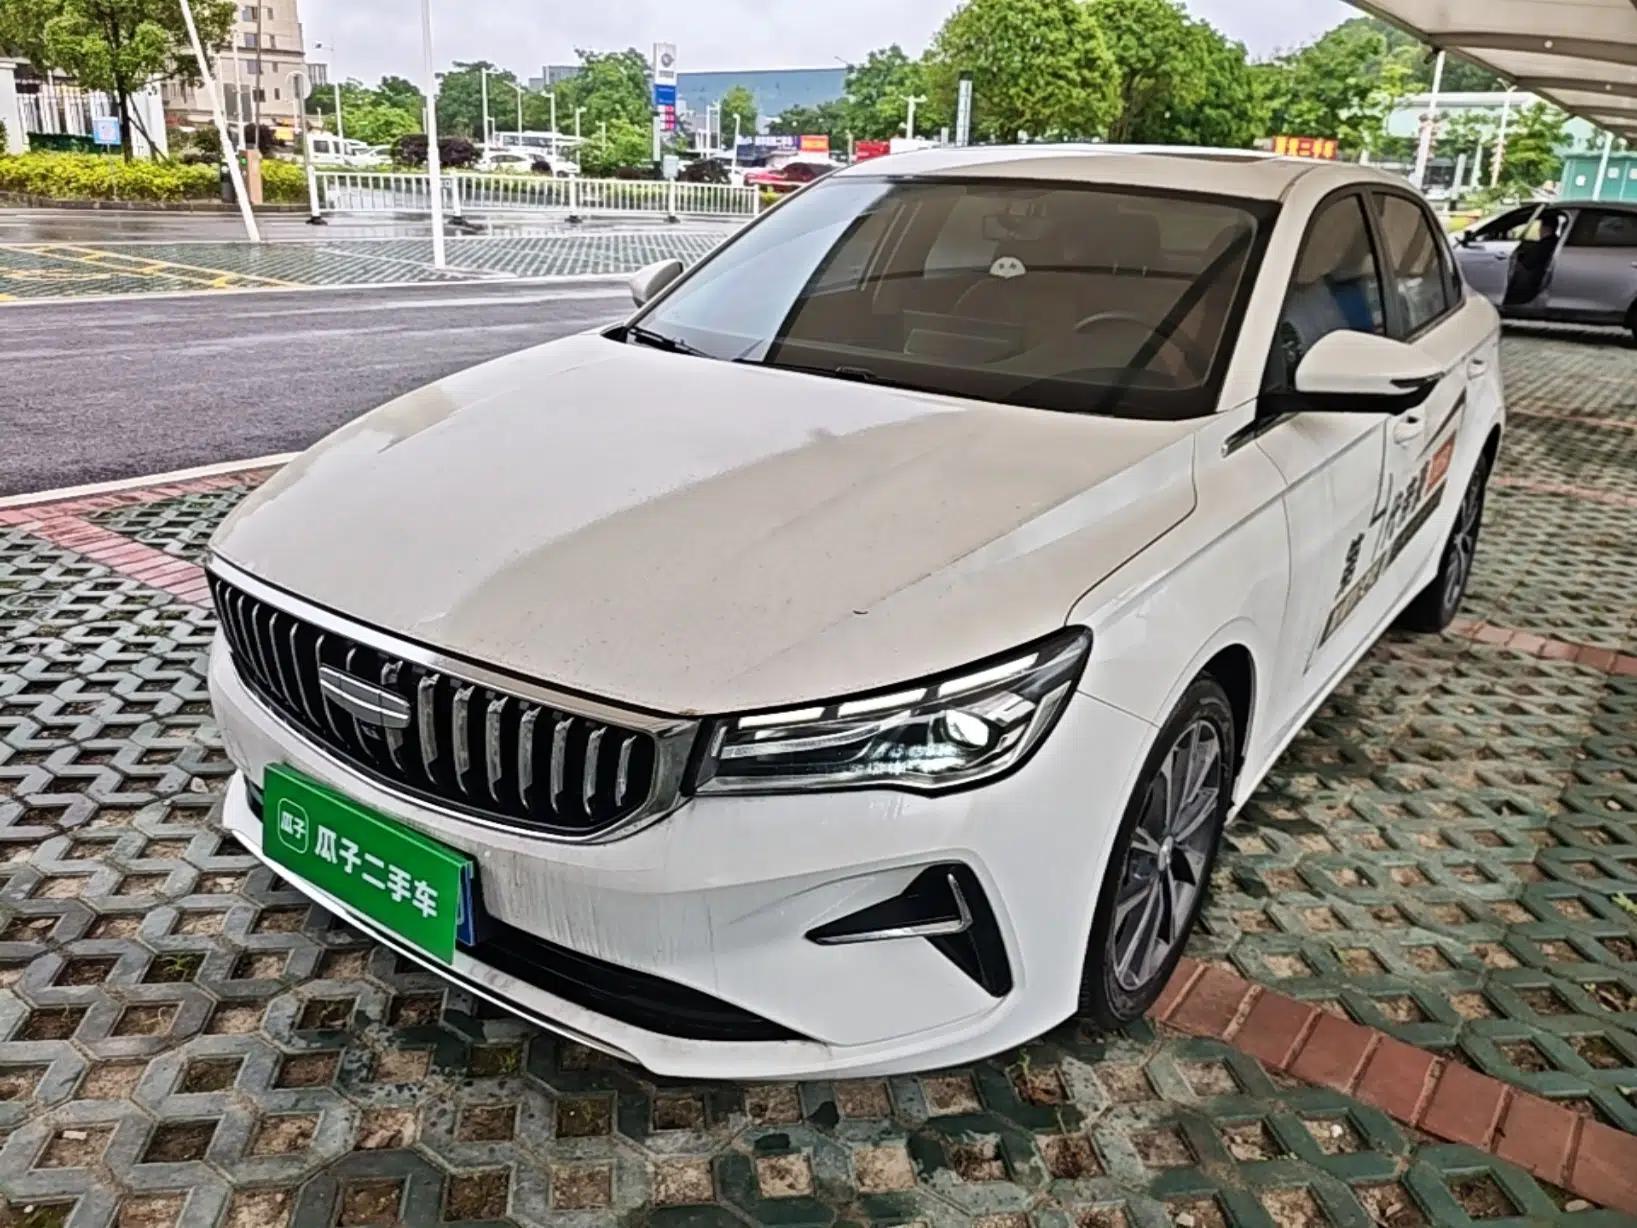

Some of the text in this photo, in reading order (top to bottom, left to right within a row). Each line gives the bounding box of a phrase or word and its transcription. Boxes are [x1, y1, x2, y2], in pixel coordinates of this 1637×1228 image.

[281, 812, 306, 839] 瓜子
[314, 825, 438, 918] 瓜子二手车
